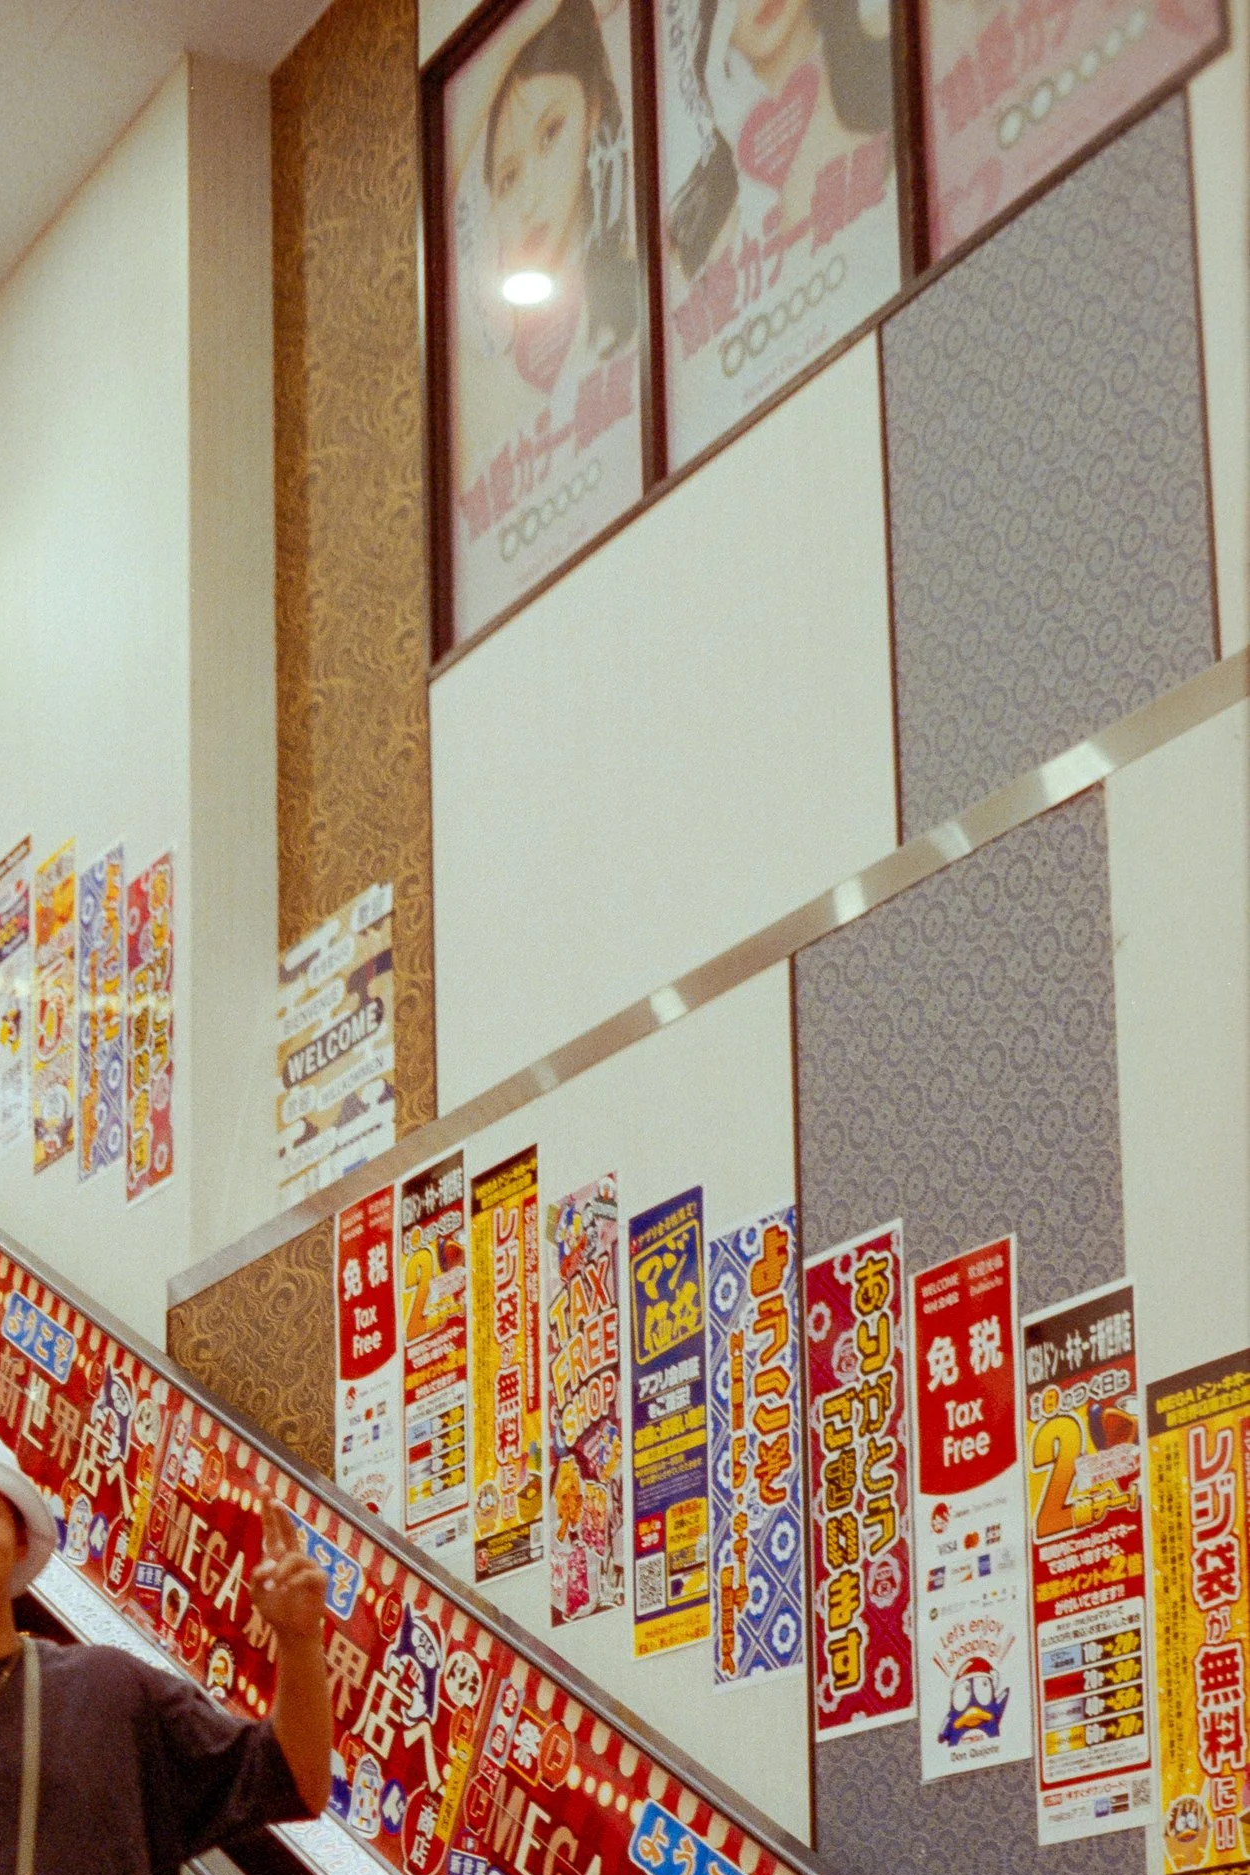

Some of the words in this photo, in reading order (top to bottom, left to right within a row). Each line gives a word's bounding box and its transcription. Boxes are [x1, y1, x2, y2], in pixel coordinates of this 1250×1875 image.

[286, 1000, 380, 1087] WELCOME
[343, 1241, 388, 1301] 免税
[549, 1262, 612, 1335] TAX
[7, 1297, 76, 1378] ようこそ
[353, 1306, 378, 1333] Tax
[353, 1331, 383, 1361] Free
[926, 1315, 1003, 1392] 免税
[551, 1315, 620, 1408] FREE
[750, 1225, 790, 1505] ようこそ
[562, 1373, 617, 1446] SHOP
[854, 1251, 895, 1556] ありがとう
[945, 1398, 983, 1431] Tax
[943, 1431, 990, 1467] Free
[161, 1498, 246, 1622] MEGA
[821, 1387, 867, 1692] ございます
[940, 1620, 965, 1649] Let's
[969, 1615, 1004, 1634] enjoy
[1189, 1427, 1245, 1850] レジ袋が無料に!!
[409, 1802, 434, 1868] 商店
